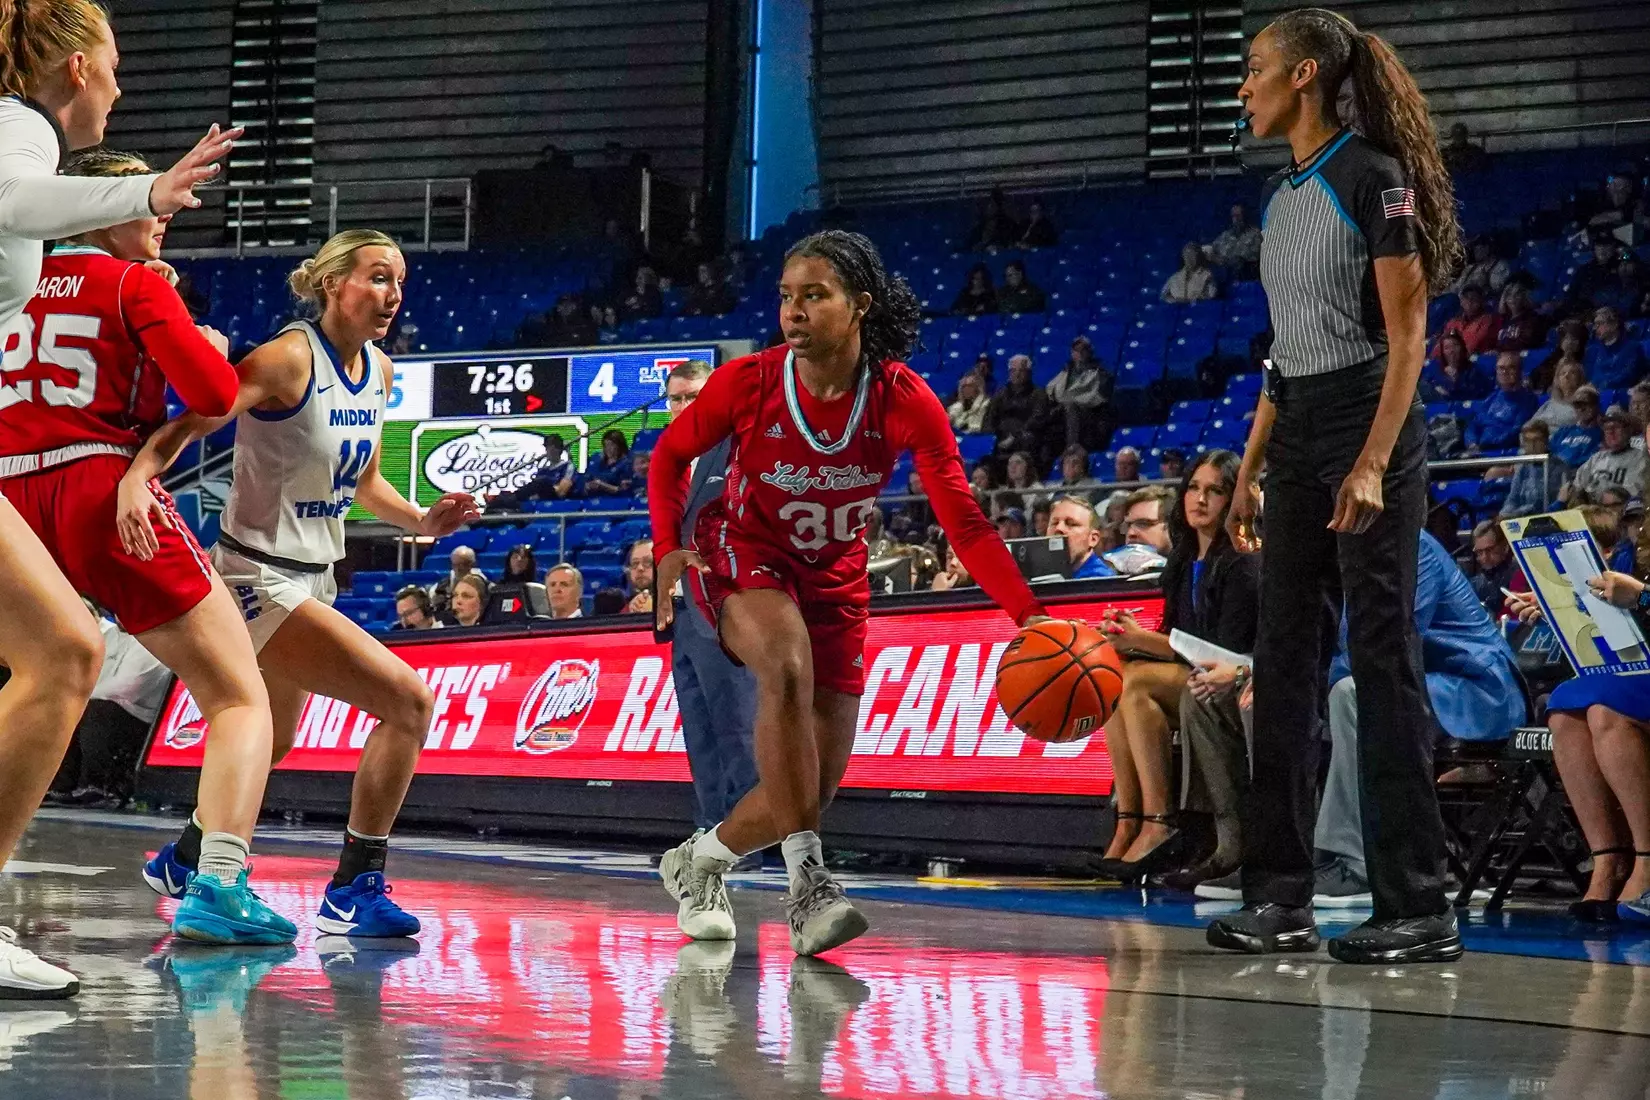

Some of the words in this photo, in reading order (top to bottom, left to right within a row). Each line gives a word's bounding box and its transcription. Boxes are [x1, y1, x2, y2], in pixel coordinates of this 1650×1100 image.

[34, 275, 85, 299] ARON
[0, 312, 101, 409] 25
[467, 363, 534, 395] 7:26
[588, 362, 618, 403] 4
[485, 397, 511, 415] 1st
[438, 442, 551, 474] Lascassa
[760, 461, 813, 495] Lady
[778, 496, 876, 551] 30
[851, 641, 1091, 758] CAN
[1515, 731, 1539, 750] BLUE
[1541, 733, 1554, 751] RA
